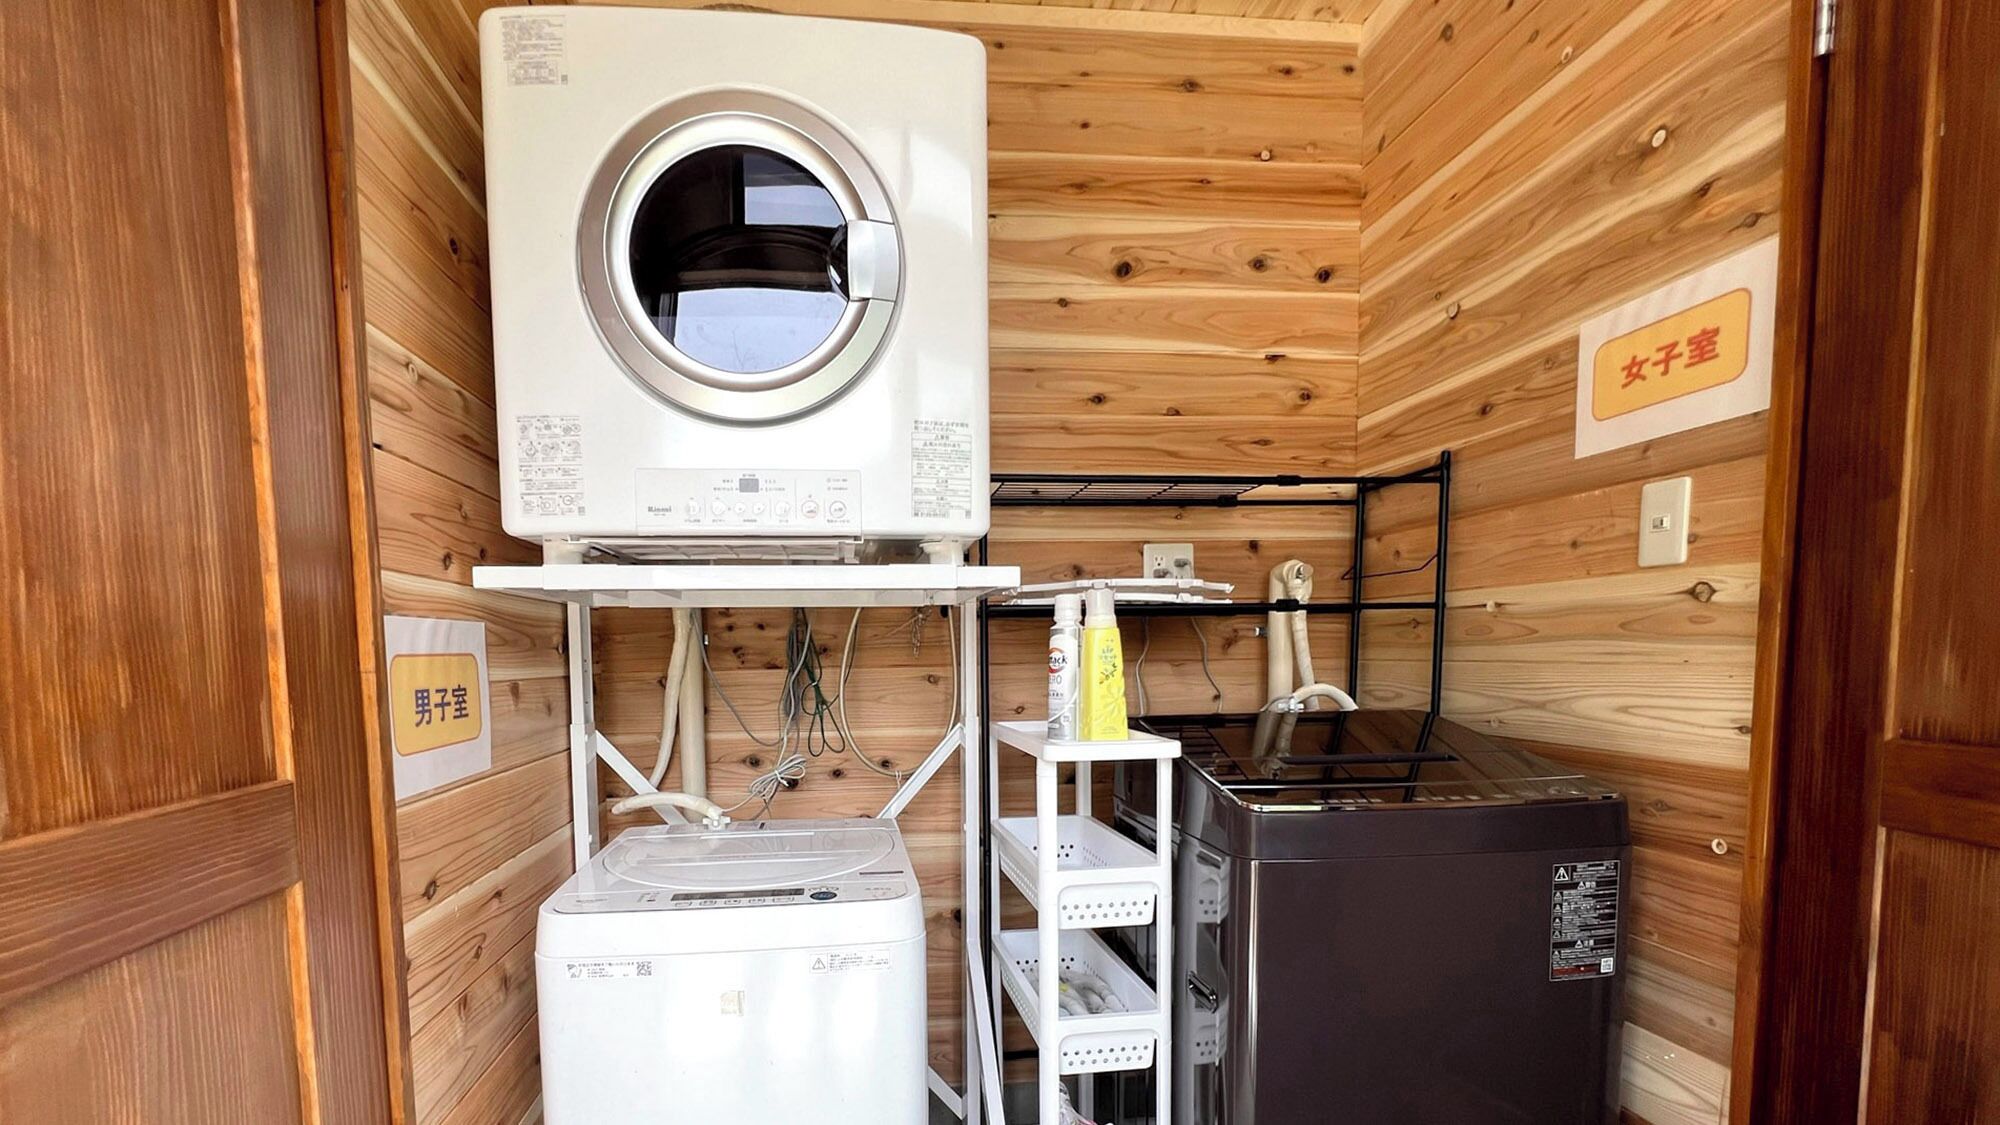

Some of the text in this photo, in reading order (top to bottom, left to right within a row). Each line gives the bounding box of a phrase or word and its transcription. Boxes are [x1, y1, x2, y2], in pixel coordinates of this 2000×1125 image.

[1620, 326, 1720, 390] 女子室
[414, 684, 469, 728] 男子室
